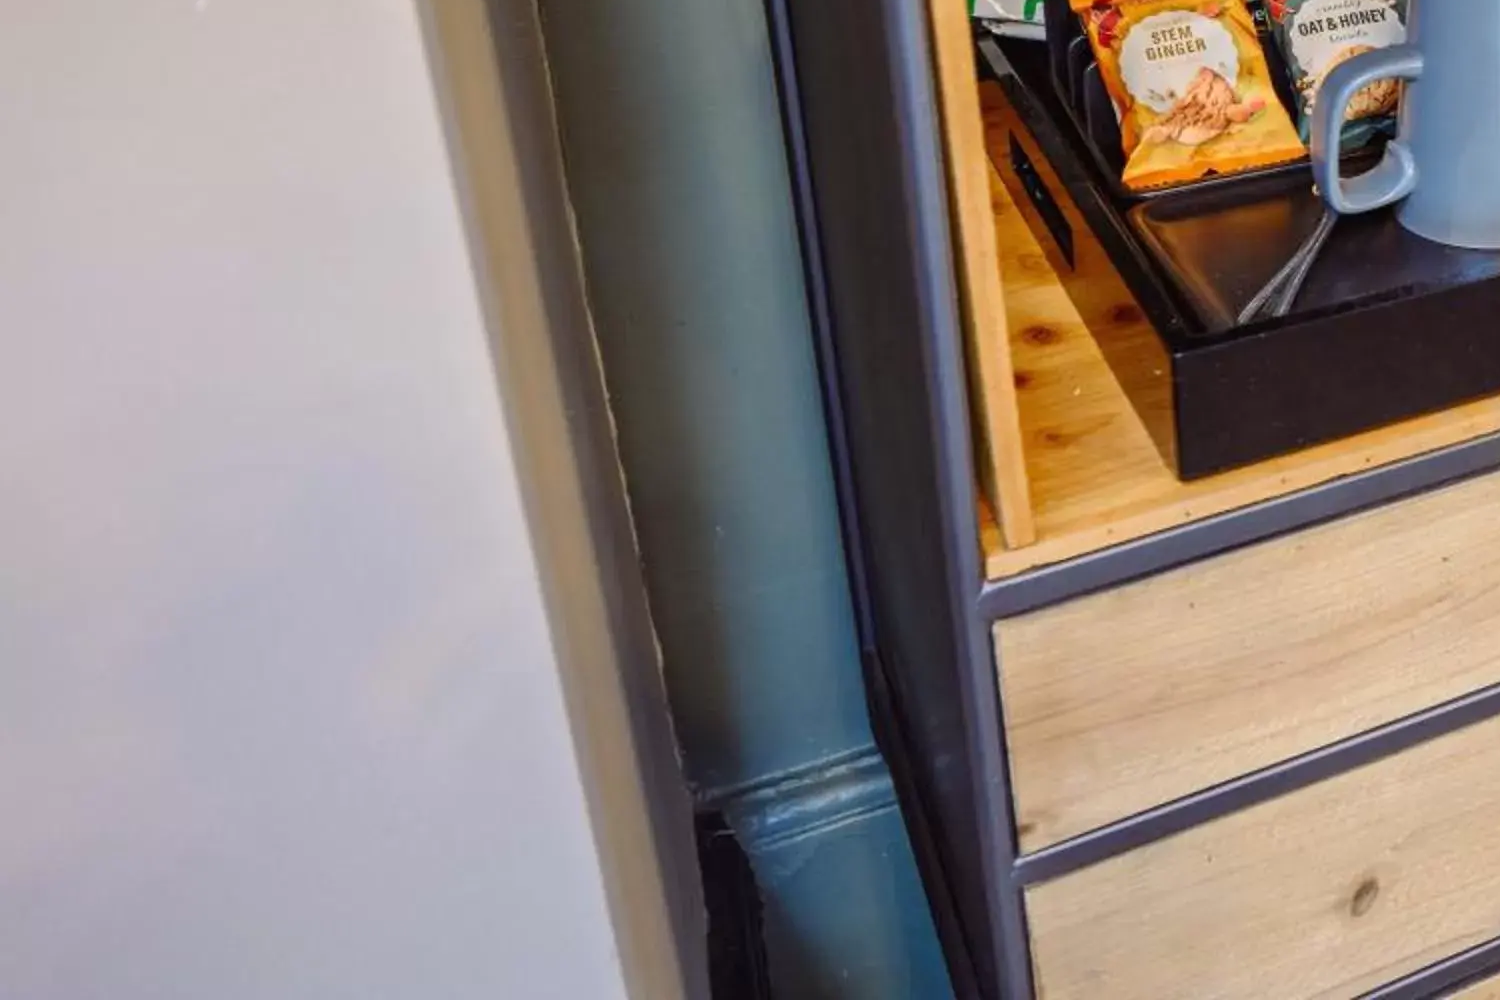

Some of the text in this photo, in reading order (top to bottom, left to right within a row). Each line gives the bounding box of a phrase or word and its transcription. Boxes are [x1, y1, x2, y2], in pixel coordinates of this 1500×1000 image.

[1298, 7, 1386, 36] OAT & HONEY
[1151, 25, 1193, 45] STEM
[1145, 38, 1207, 61] GINGER
